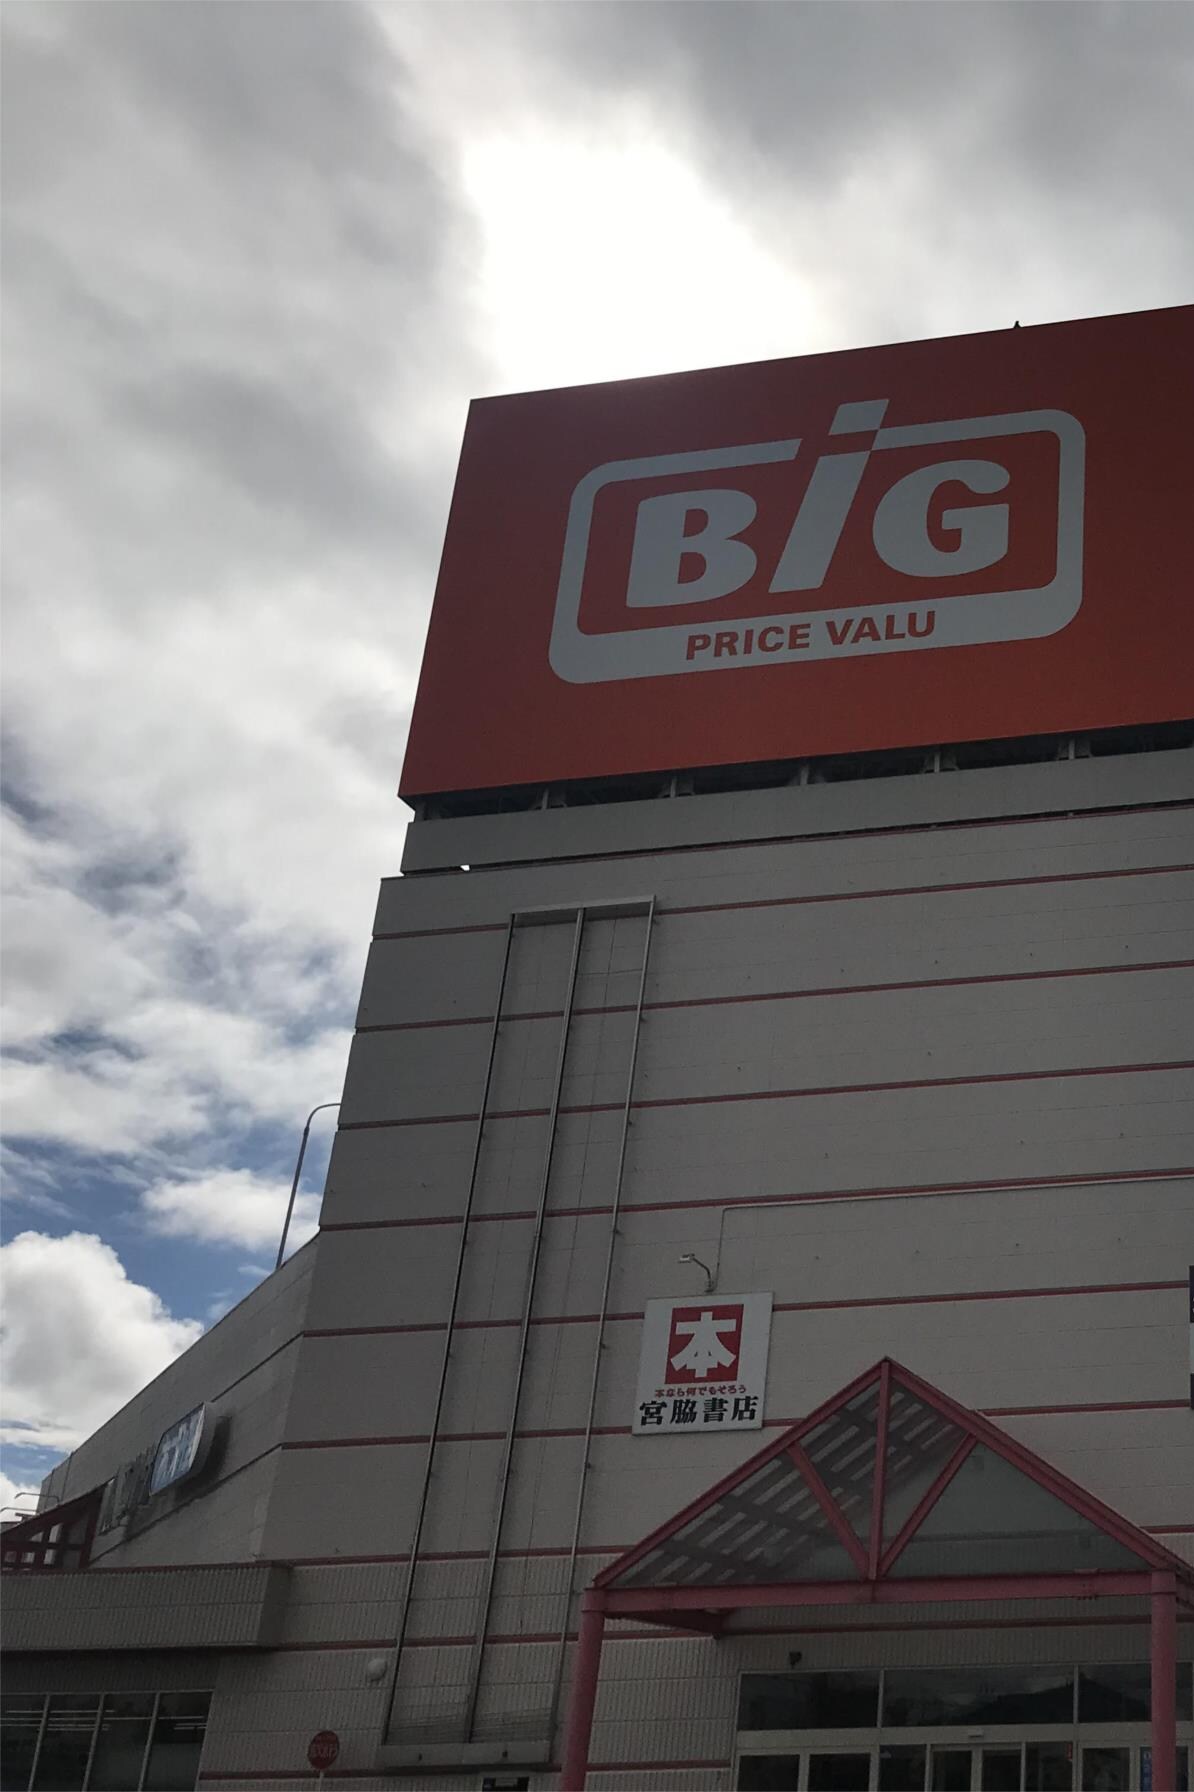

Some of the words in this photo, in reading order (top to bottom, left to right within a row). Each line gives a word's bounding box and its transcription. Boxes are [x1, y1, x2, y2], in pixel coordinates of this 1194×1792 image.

[685, 623, 812, 661] PRICE
[825, 610, 936, 647] VALU
[669, 1311, 738, 1379] 本
[639, 1396, 760, 1427] 宮脇書店
